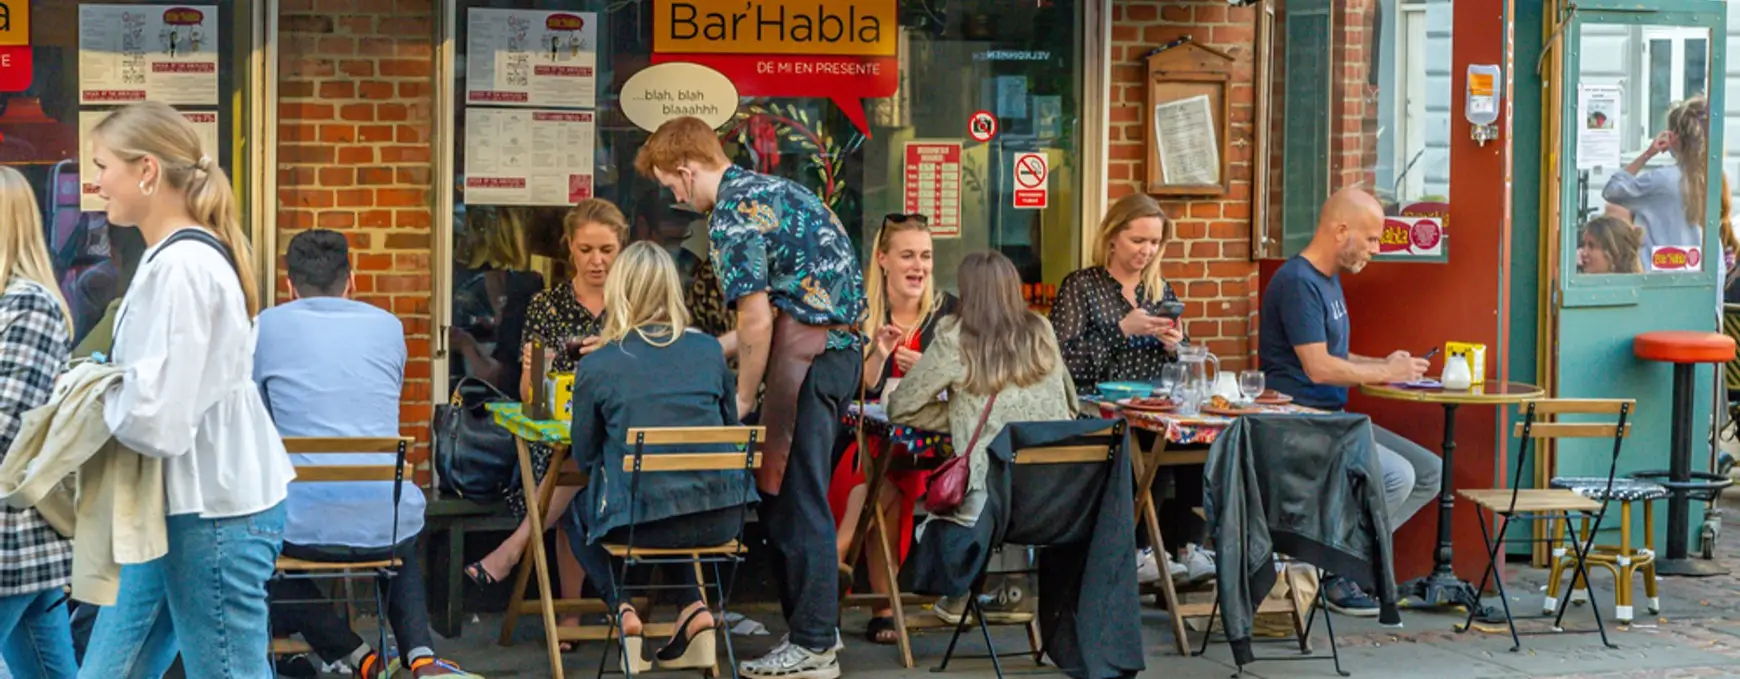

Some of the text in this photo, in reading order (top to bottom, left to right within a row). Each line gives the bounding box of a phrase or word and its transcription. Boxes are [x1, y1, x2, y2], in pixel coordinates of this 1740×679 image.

[670, 1, 881, 43] Bar'Habla
[756, 61, 881, 76] DE MI EN PRESENTE
[678, 89, 704, 101] blah
[662, 104, 718, 115] blaaahhh
